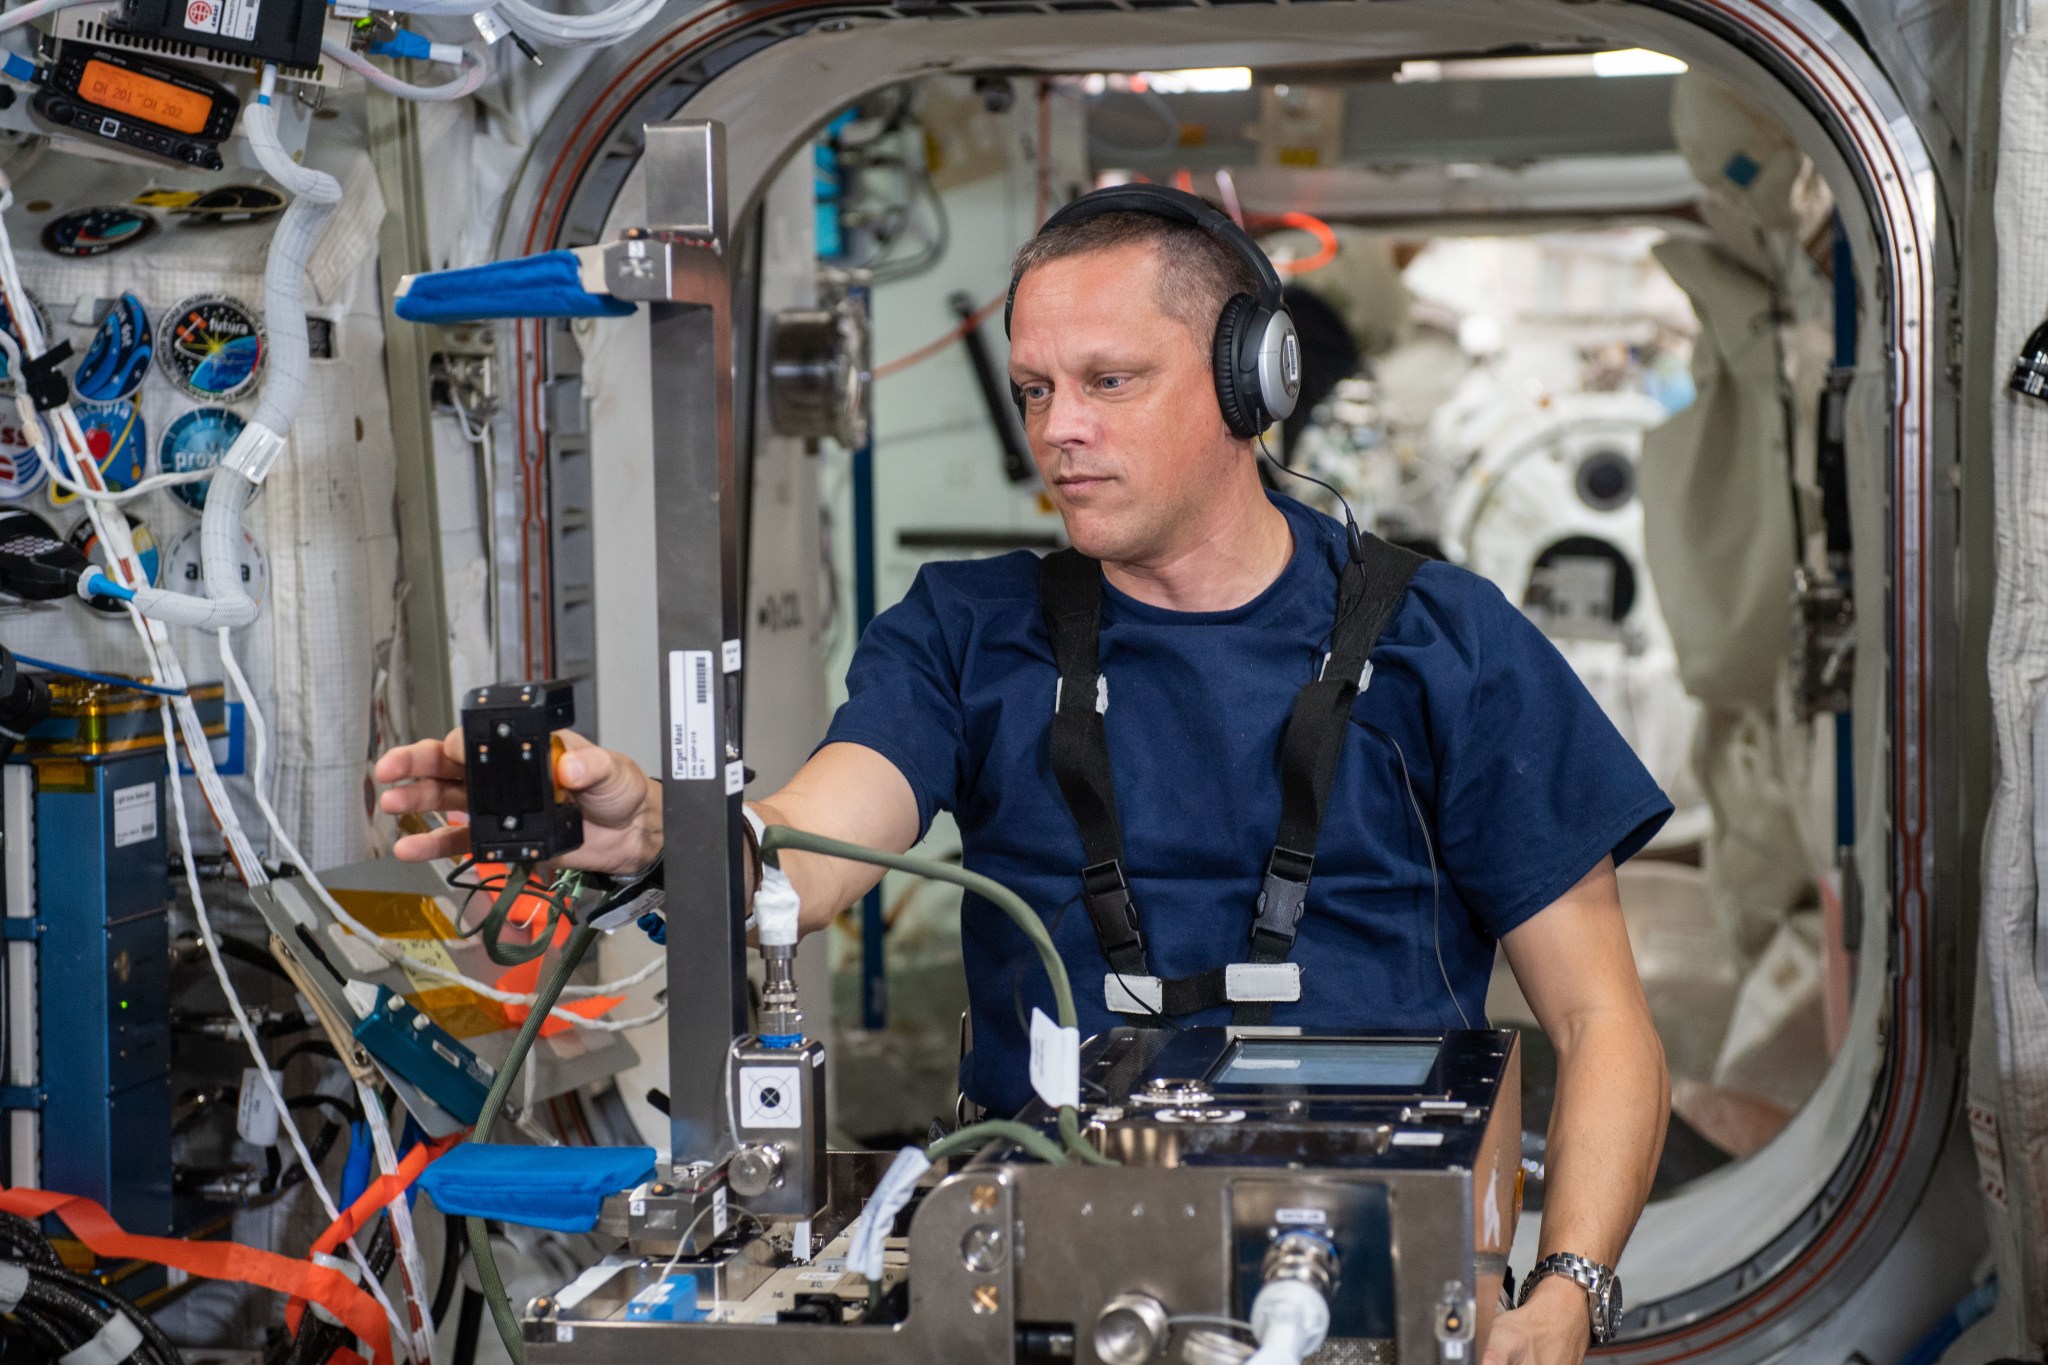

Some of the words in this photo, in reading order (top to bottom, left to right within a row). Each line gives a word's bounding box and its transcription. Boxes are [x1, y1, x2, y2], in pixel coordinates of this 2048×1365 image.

[93, 81, 108, 95] CH
[112, 87, 132, 103] 201
[143, 97, 158, 111] CH
[162, 103, 183, 118] 202
[208, 318, 249, 335] futura
[674, 724, 683, 746] Mast
[674, 747, 687, 776] Target
